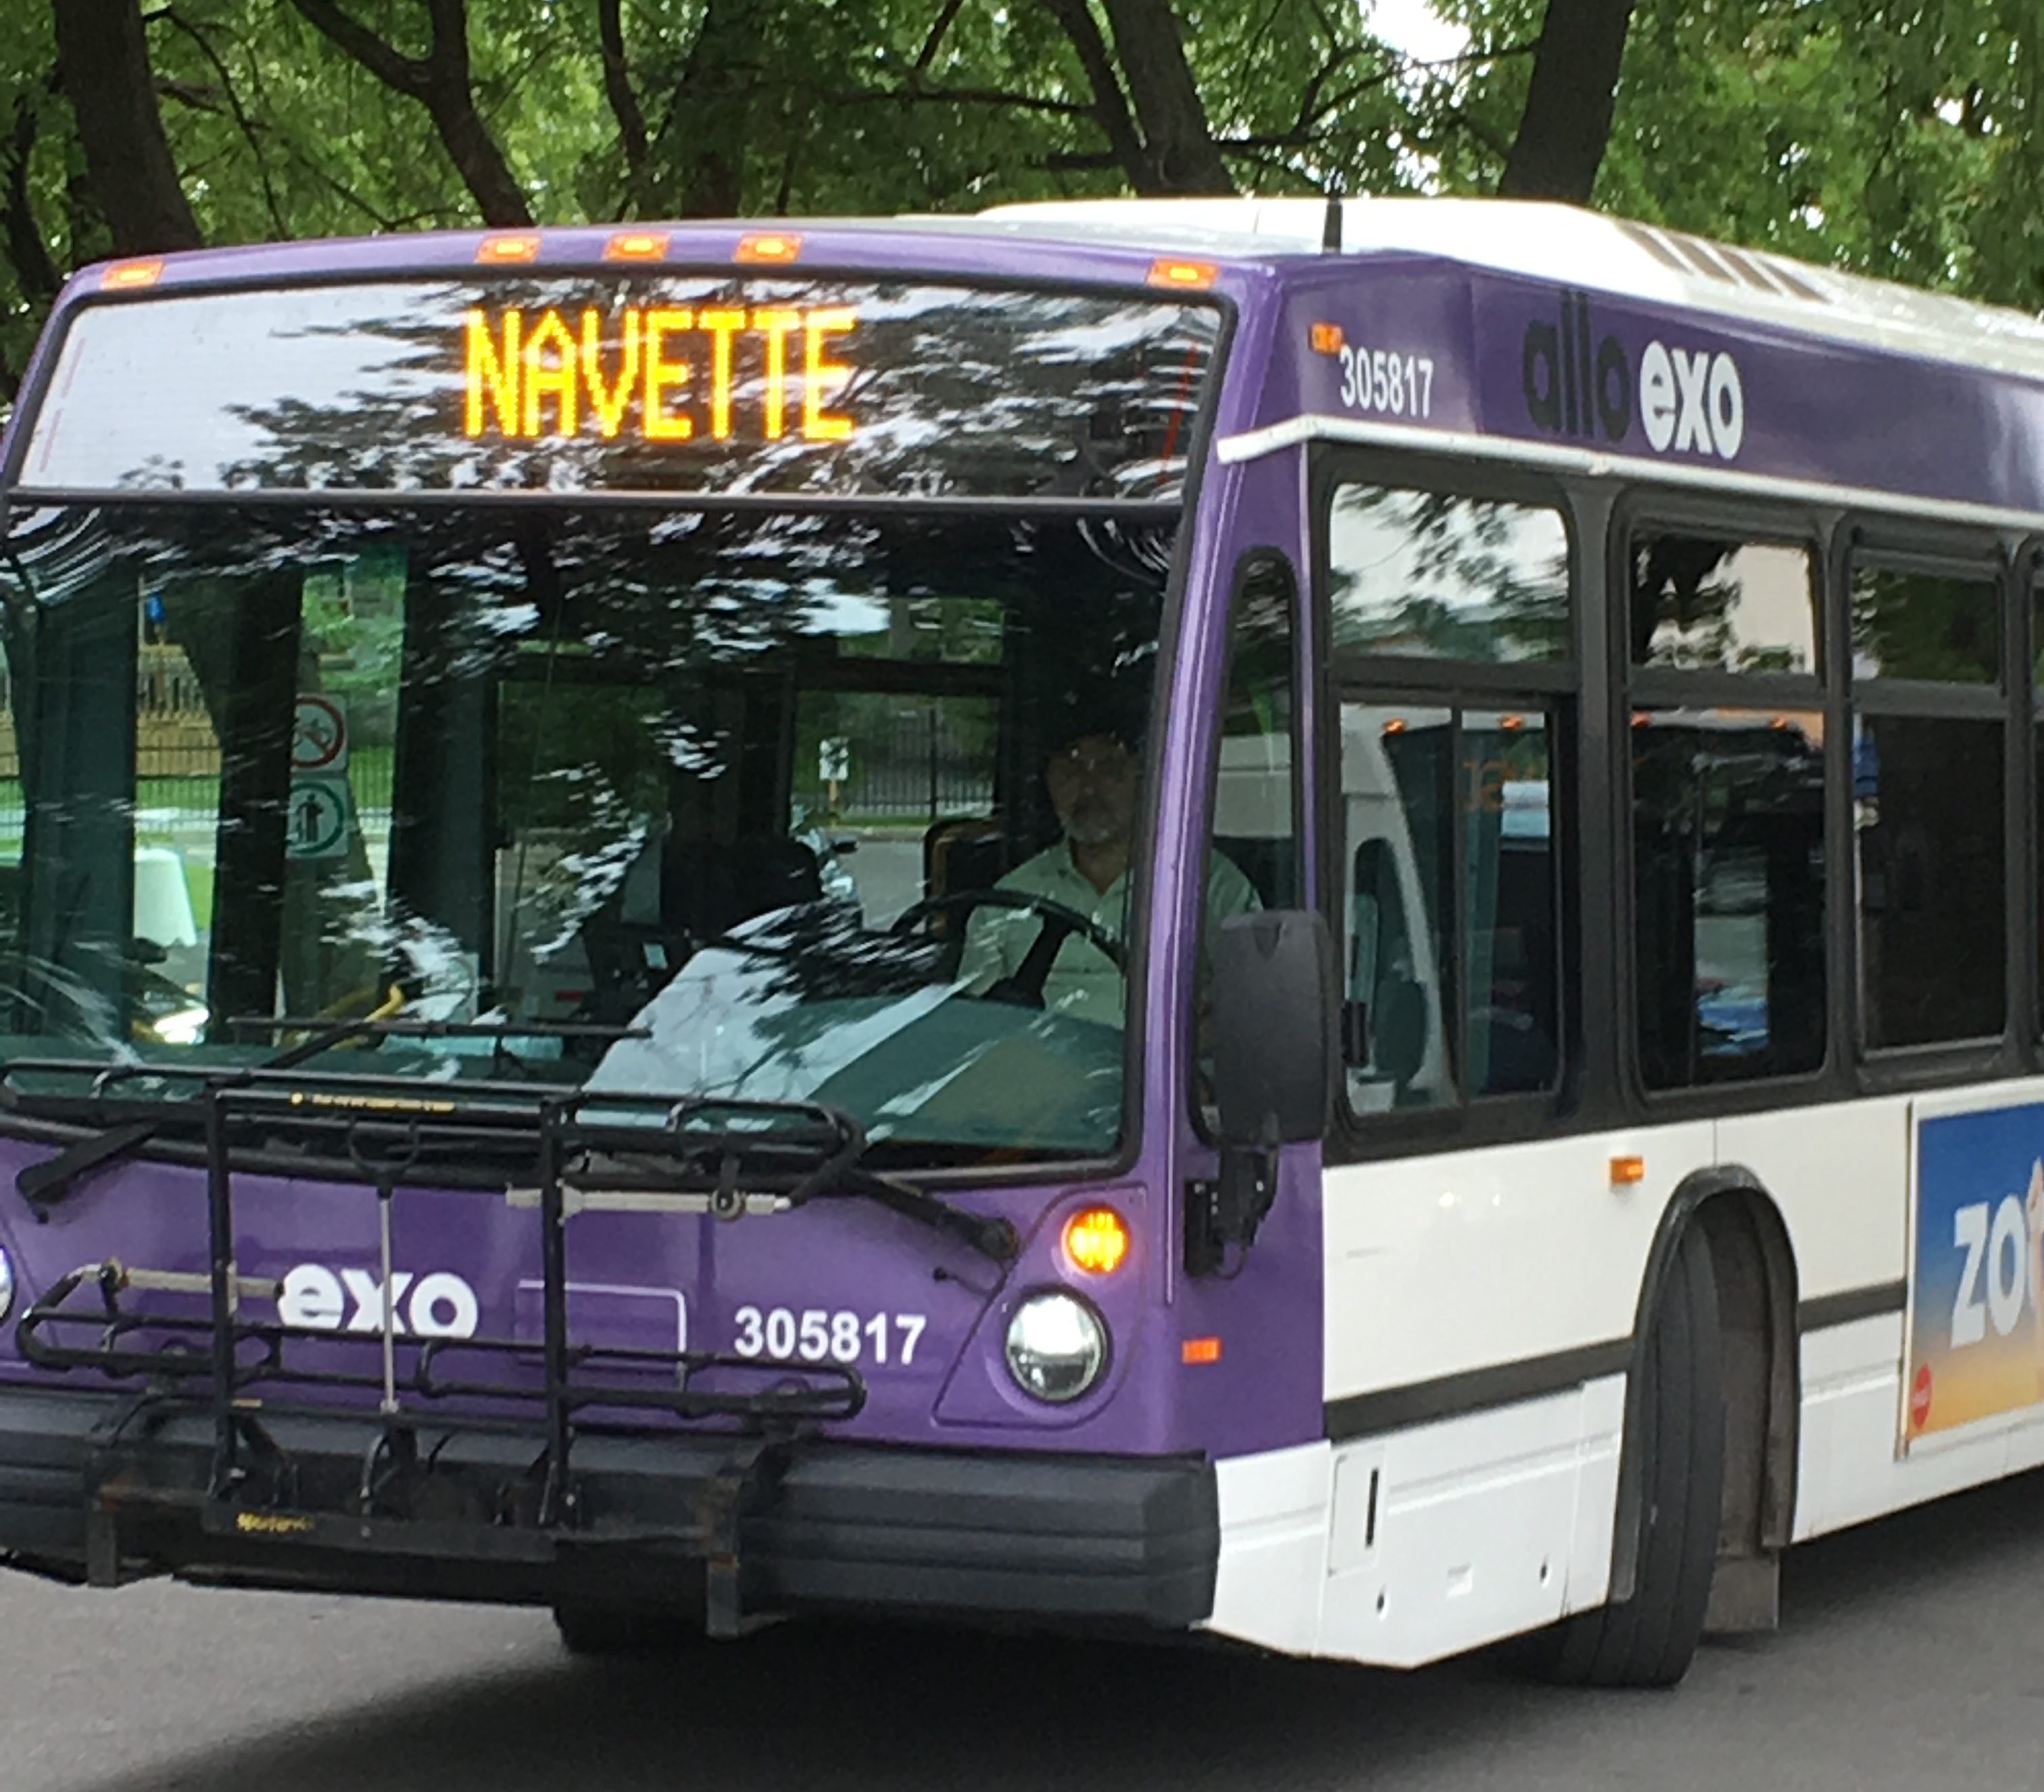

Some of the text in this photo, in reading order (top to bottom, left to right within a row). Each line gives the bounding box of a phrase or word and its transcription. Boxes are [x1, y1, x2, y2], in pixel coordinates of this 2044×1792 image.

[465, 308, 857, 440] NAVETTE
[1339, 344, 1434, 418] 305817
[1523, 288, 1743, 460] allo exo
[277, 1263, 478, 1339] exo
[734, 1305, 927, 1365] 305817
